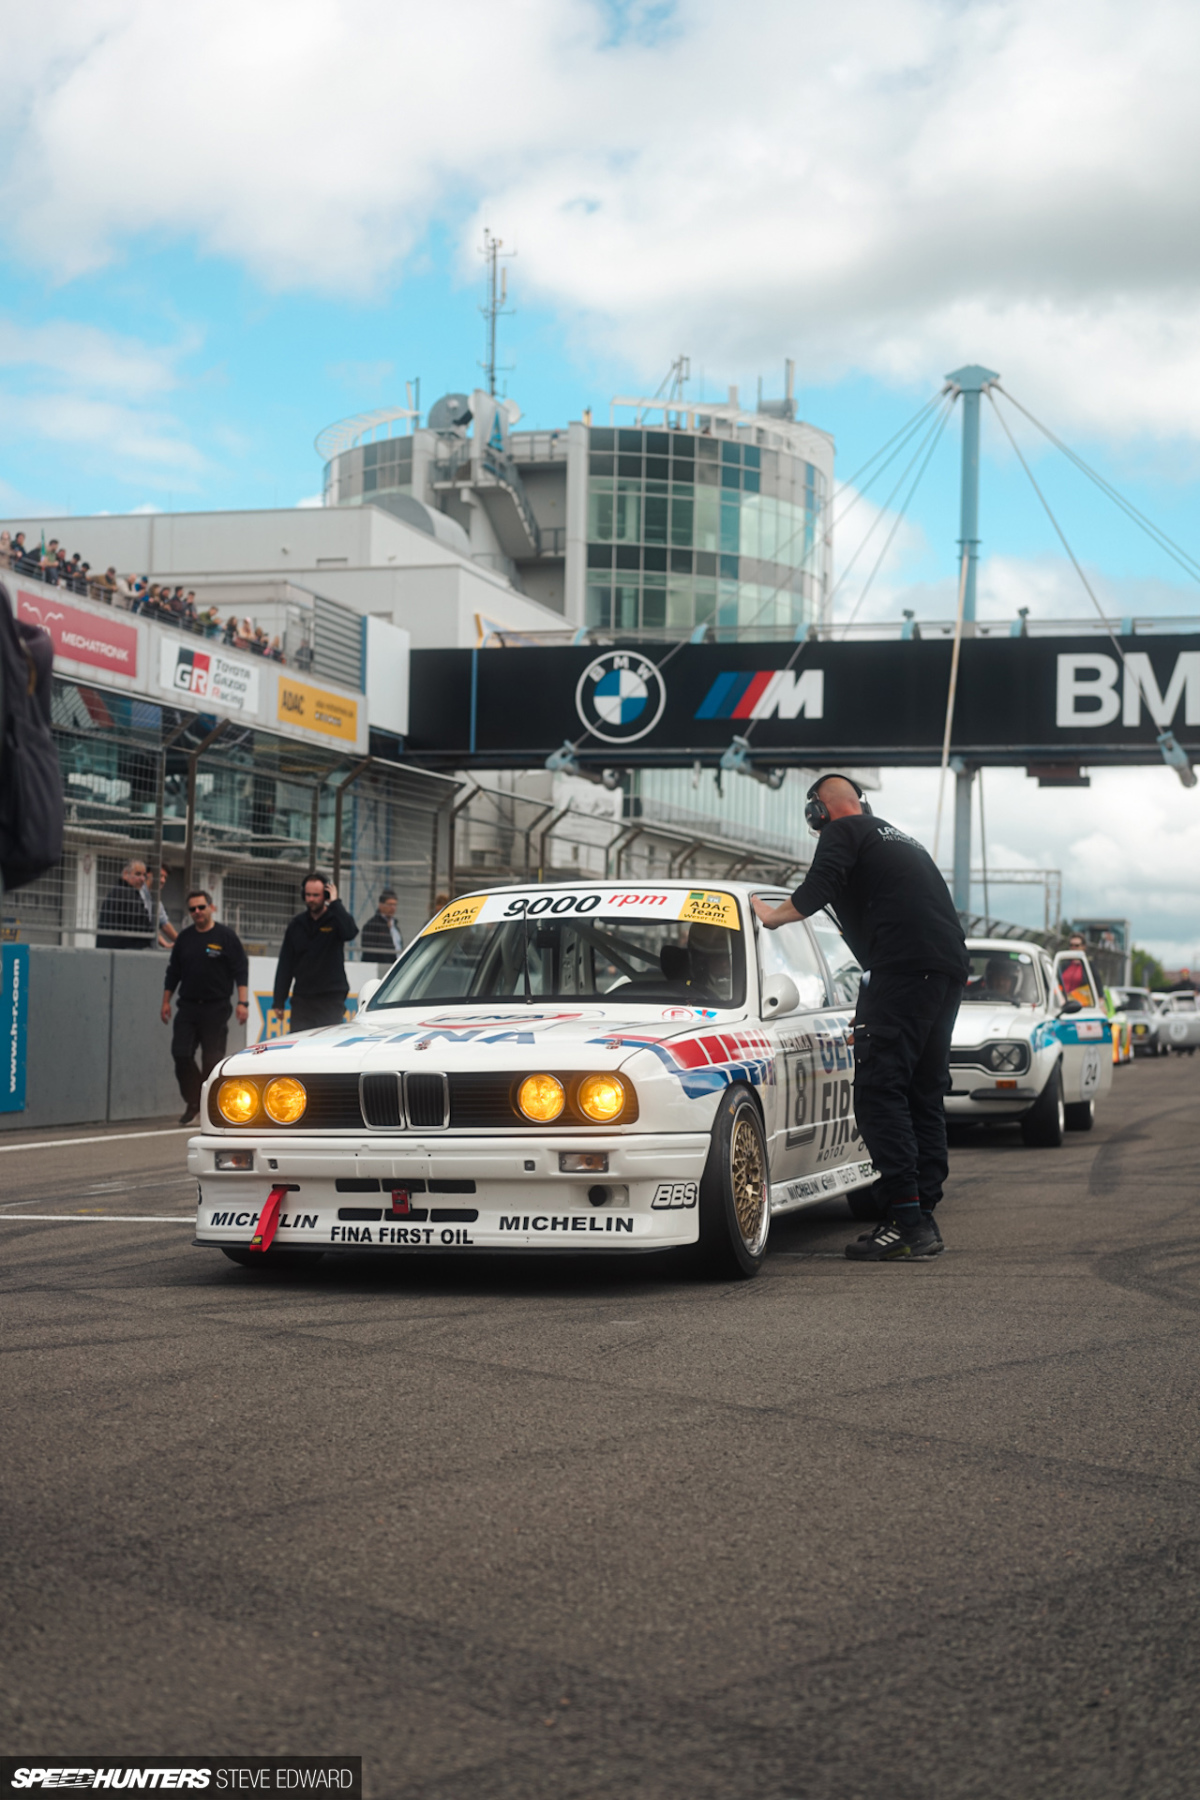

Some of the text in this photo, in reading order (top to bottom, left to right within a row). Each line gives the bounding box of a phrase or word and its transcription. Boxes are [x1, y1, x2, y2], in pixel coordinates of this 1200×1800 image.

[61, 630, 129, 661] MECHATRONIK
[175, 662, 208, 694] GR
[216, 659, 251, 679] TOYOTA
[588, 655, 653, 683] BMW
[213, 673, 247, 692] GAZOO
[211, 686, 245, 709] Racing
[282, 689, 305, 716] ADAC
[442, 906, 479, 920] ADAC
[503, 893, 669, 917] 9000 rpm
[690, 901, 731, 912] ADAC
[692, 908, 725, 918] Team
[443, 915, 471, 925] Team
[10, 958, 20, 1093] www.h-r.com
[434, 1014, 545, 1023] FINA
[333, 1030, 535, 1047] FINA
[1085, 1063, 1097, 1086] 24
[816, 1145, 845, 1163] MOTOR
[651, 1182, 698, 1210] BBS
[787, 1180, 820, 1200] MICHELIN
[499, 1216, 634, 1232] MICHELIN
[330, 1226, 474, 1245] FINA FIRST OIL
